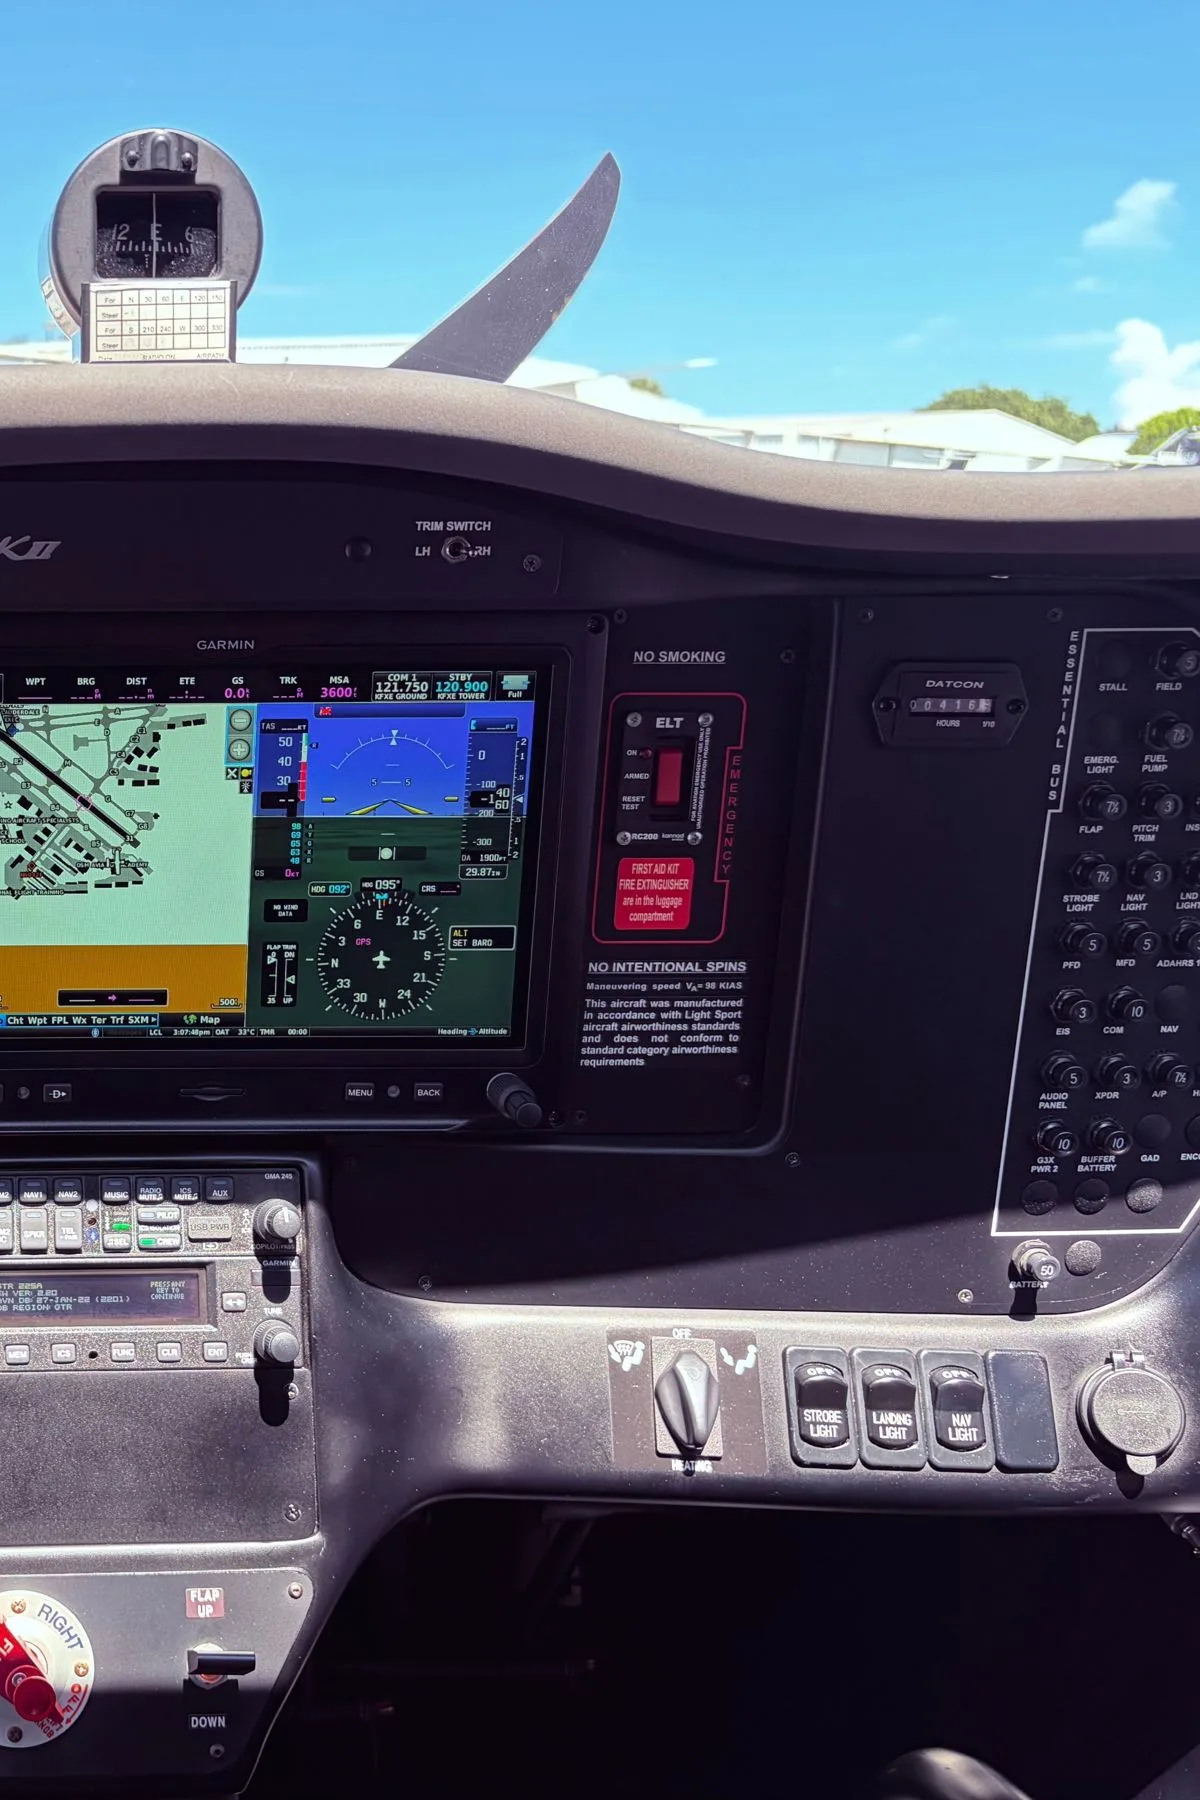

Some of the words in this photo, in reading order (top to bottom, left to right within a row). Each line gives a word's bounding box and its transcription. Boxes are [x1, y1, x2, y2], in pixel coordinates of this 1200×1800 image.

[111, 223, 130, 241] 12
[415, 521, 445, 532] TRIM
[446, 521, 492, 532] SWITCH
[415, 546, 431, 557] LH
[196, 640, 255, 650] GARMIN
[633, 651, 656, 662] NO
[658, 651, 726, 663] SMOKING
[375, 682, 429, 693] 121.750
[435, 681, 488, 693] 120.900
[925, 680, 984, 689] DATCON
[1055, 630, 1079, 749] ESSENTIAL
[1099, 683, 1128, 691] STALL
[1155, 683, 1182, 691] FIELD
[655, 717, 684, 729] ELT
[1083, 756, 1119, 764] EMERG.
[1144, 755, 1168, 763] FUEL
[1086, 765, 1115, 774] LIGHT
[1141, 764, 1168, 773] PUMP
[1047, 763, 1061, 801] BUS
[722, 754, 742, 874] EMERGENCY
[1079, 825, 1103, 833] FLAP
[1132, 825, 1159, 833] PITCH
[1133, 834, 1155, 842] TRIM
[631, 863, 653, 874] FIRST
[653, 863, 666, 874] AID
[667, 863, 680, 874] KIT
[618, 879, 636, 890] FIRE
[636, 879, 689, 890] EXTINGUISHER
[622, 897, 634, 906] are
[635, 895, 642, 906] in
[643, 895, 654, 906] the
[655, 895, 683, 908] luggage
[1062, 894, 1100, 902] STROBE
[1066, 904, 1094, 912] LIGHT
[629, 911, 674, 924] compartment
[588, 962, 609, 972] NO
[612, 962, 703, 972] INTENTIONAL
[706, 961, 747, 972] SPINS
[1062, 961, 1081, 969] PFD
[1116, 959, 1136, 967] MFD
[586, 982, 647, 992] Maneuvering
[652, 983, 681, 991] speed
[704, 982, 716, 990] 98
[719, 982, 743, 990] KIAS
[585, 999, 606, 1008] This
[610, 999, 647, 1008] aircraft
[649, 1000, 670, 1008] was
[673, 998, 743, 1008] manufactured
[7, 1015, 24, 1025] Cht
[28, 1015, 48, 1026] Wpt
[51, 1015, 69, 1025] FPL
[72, 1015, 87, 1025] Wx
[90, 1015, 107, 1025] Ter
[110, 1015, 125, 1025] Trf
[128, 1015, 149, 1025] SXM
[583, 1011, 593, 1019] in
[597, 1010, 656, 1019] accordance
[660, 1010, 682, 1019] with
[684, 1010, 711, 1021] Light
[714, 1010, 742, 1021] Sport
[582, 1022, 618, 1031] aircraft
[621, 1022, 689, 1031] airworthiness
[691, 1021, 740, 1031] standards
[1103, 1026, 1124, 1034] COM
[1039, 1092, 1069, 1100] AUDIO
[1094, 1092, 1119, 1100] XPDR
[1038, 1101, 1067, 1110] PANEL
[1080, 1155, 1116, 1163] BUFFER
[1140, 1154, 1160, 1162] GAD
[1077, 1164, 1117, 1172] BATTERY
[23, 1190, 43, 1199] NAV1
[58, 1190, 78, 1199] NAV2
[104, 1190, 129, 1200] MUSIC
[212, 1189, 228, 1198] AUX
[672, 1328, 692, 1339] OFF
[803, 1409, 842, 1425] STROBE
[872, 1411, 913, 1427] LANDING
[951, 1413, 972, 1428] NAV
[809, 1423, 839, 1439] LIGHT
[878, 1425, 908, 1441] LIGHT
[947, 1426, 979, 1443] LIGHT
[190, 1589, 220, 1604] FLAP
[197, 1604, 214, 1617] UP
[37, 1603, 84, 1651] RIGHT
[191, 1715, 226, 1729] DOWN
